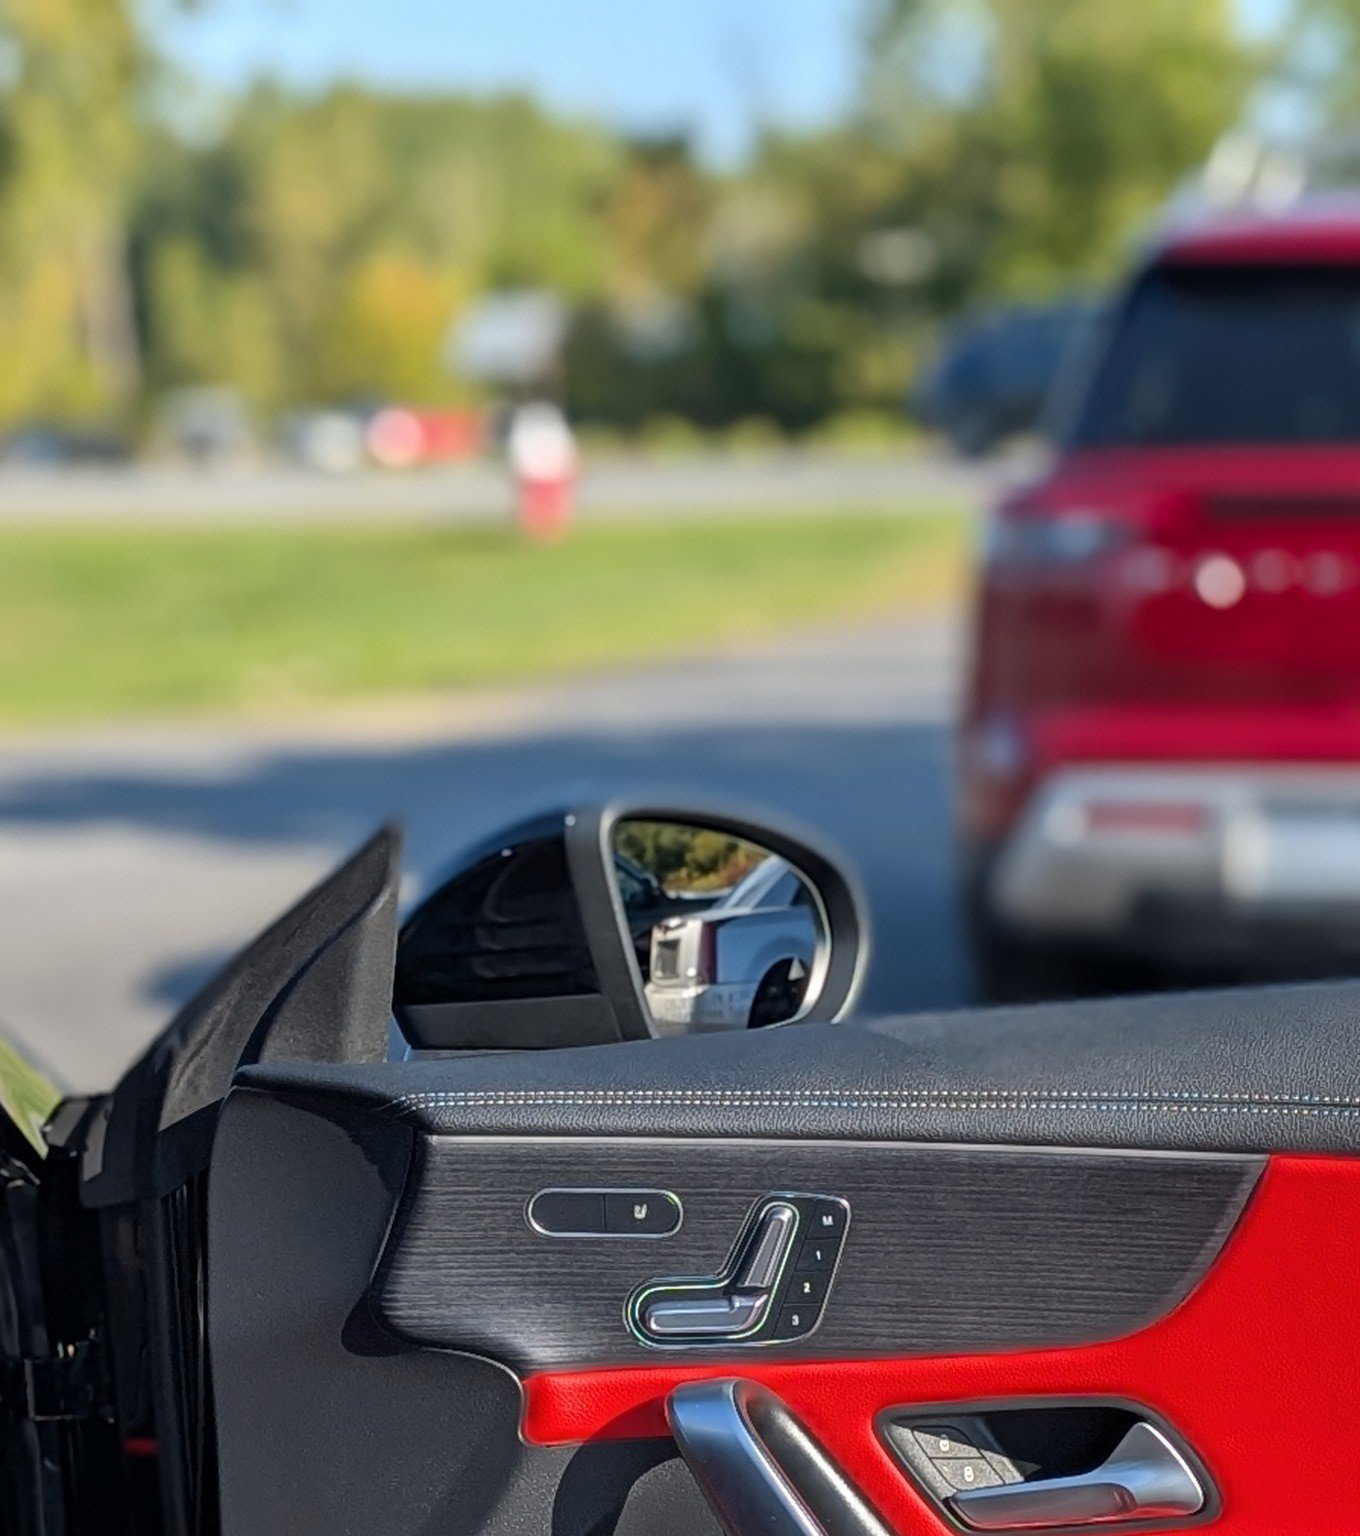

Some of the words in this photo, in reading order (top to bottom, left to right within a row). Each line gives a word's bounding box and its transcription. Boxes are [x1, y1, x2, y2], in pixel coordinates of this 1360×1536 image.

[815, 1250, 822, 1261] 1
[803, 1282, 811, 1293] 2
[791, 1314, 800, 1326] 3
